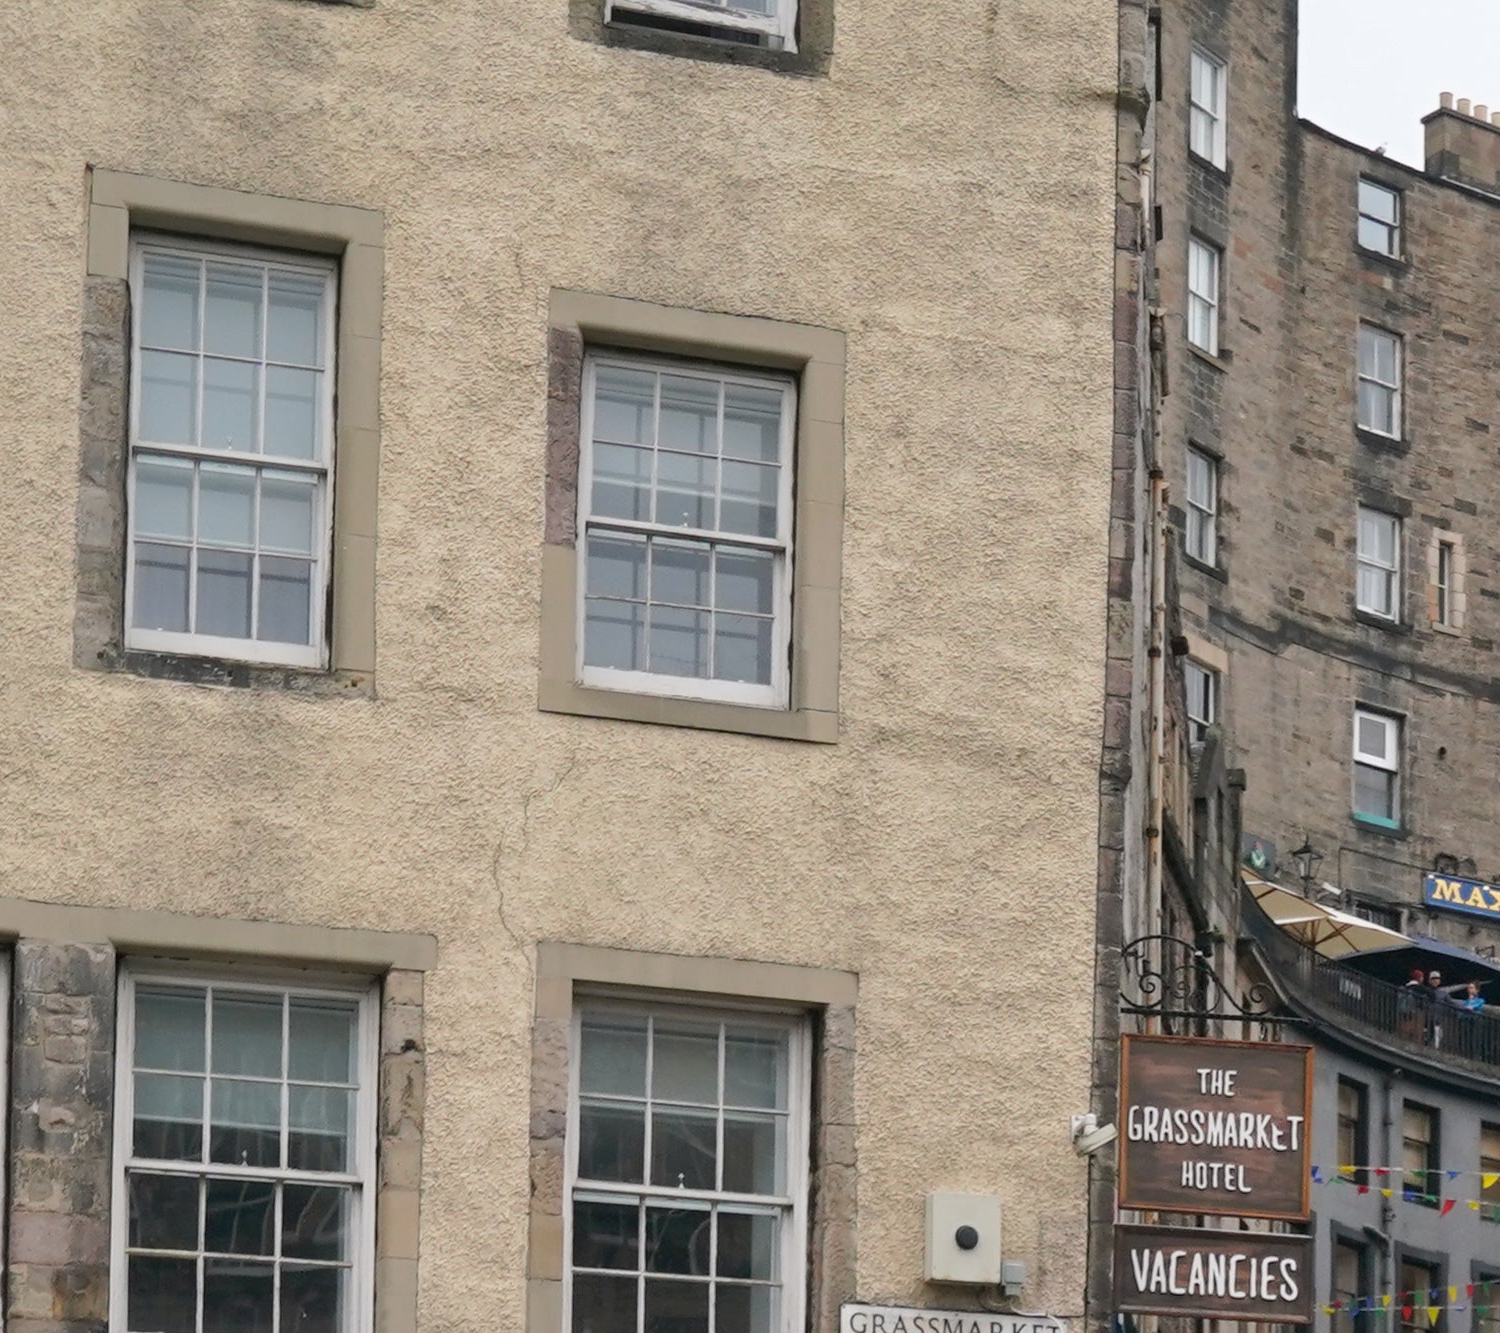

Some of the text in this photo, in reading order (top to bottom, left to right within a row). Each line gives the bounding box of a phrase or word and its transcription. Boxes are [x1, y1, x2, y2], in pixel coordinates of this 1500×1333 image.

[1197, 1067, 1238, 1098] THE
[1181, 1160, 1253, 1194] HOTEL
[1130, 1247, 1301, 1302] VACANCIES
